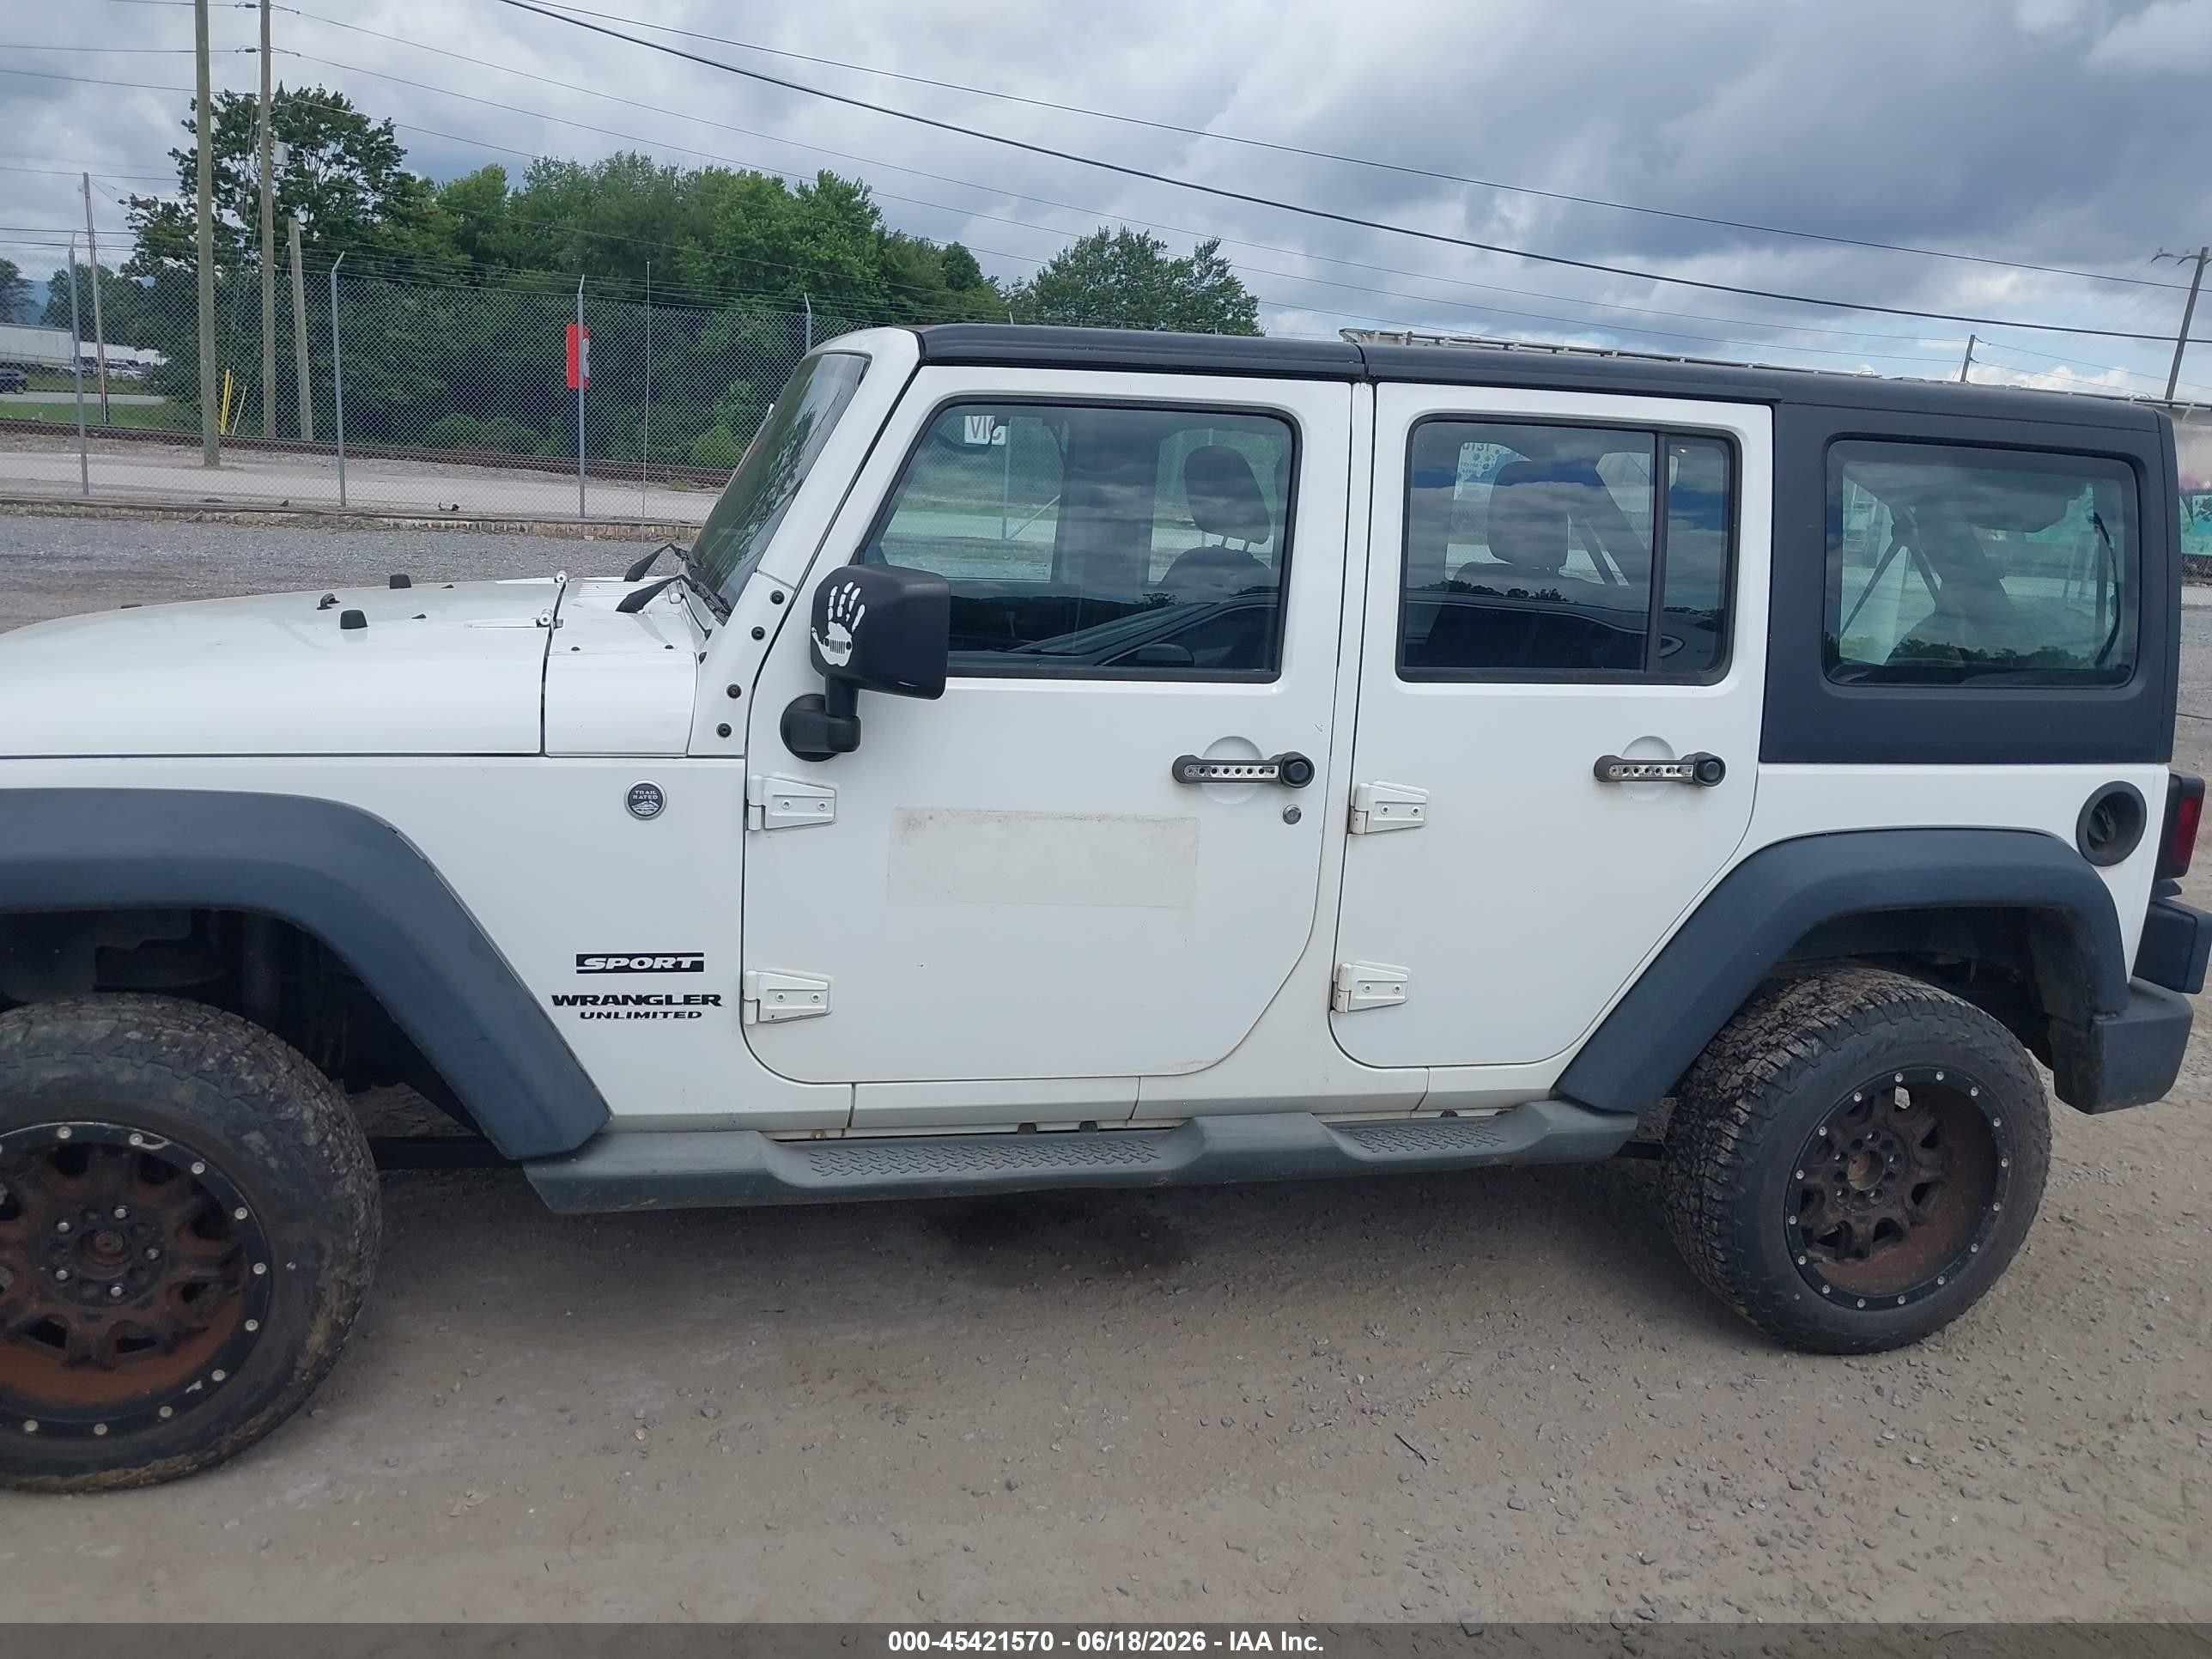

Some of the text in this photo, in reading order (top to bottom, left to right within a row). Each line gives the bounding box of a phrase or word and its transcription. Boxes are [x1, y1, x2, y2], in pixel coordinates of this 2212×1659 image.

[583, 957, 703, 970] SPORT
[551, 994, 722, 1006] WRANGLER
[580, 1011, 702, 1019] UNLIMITED
